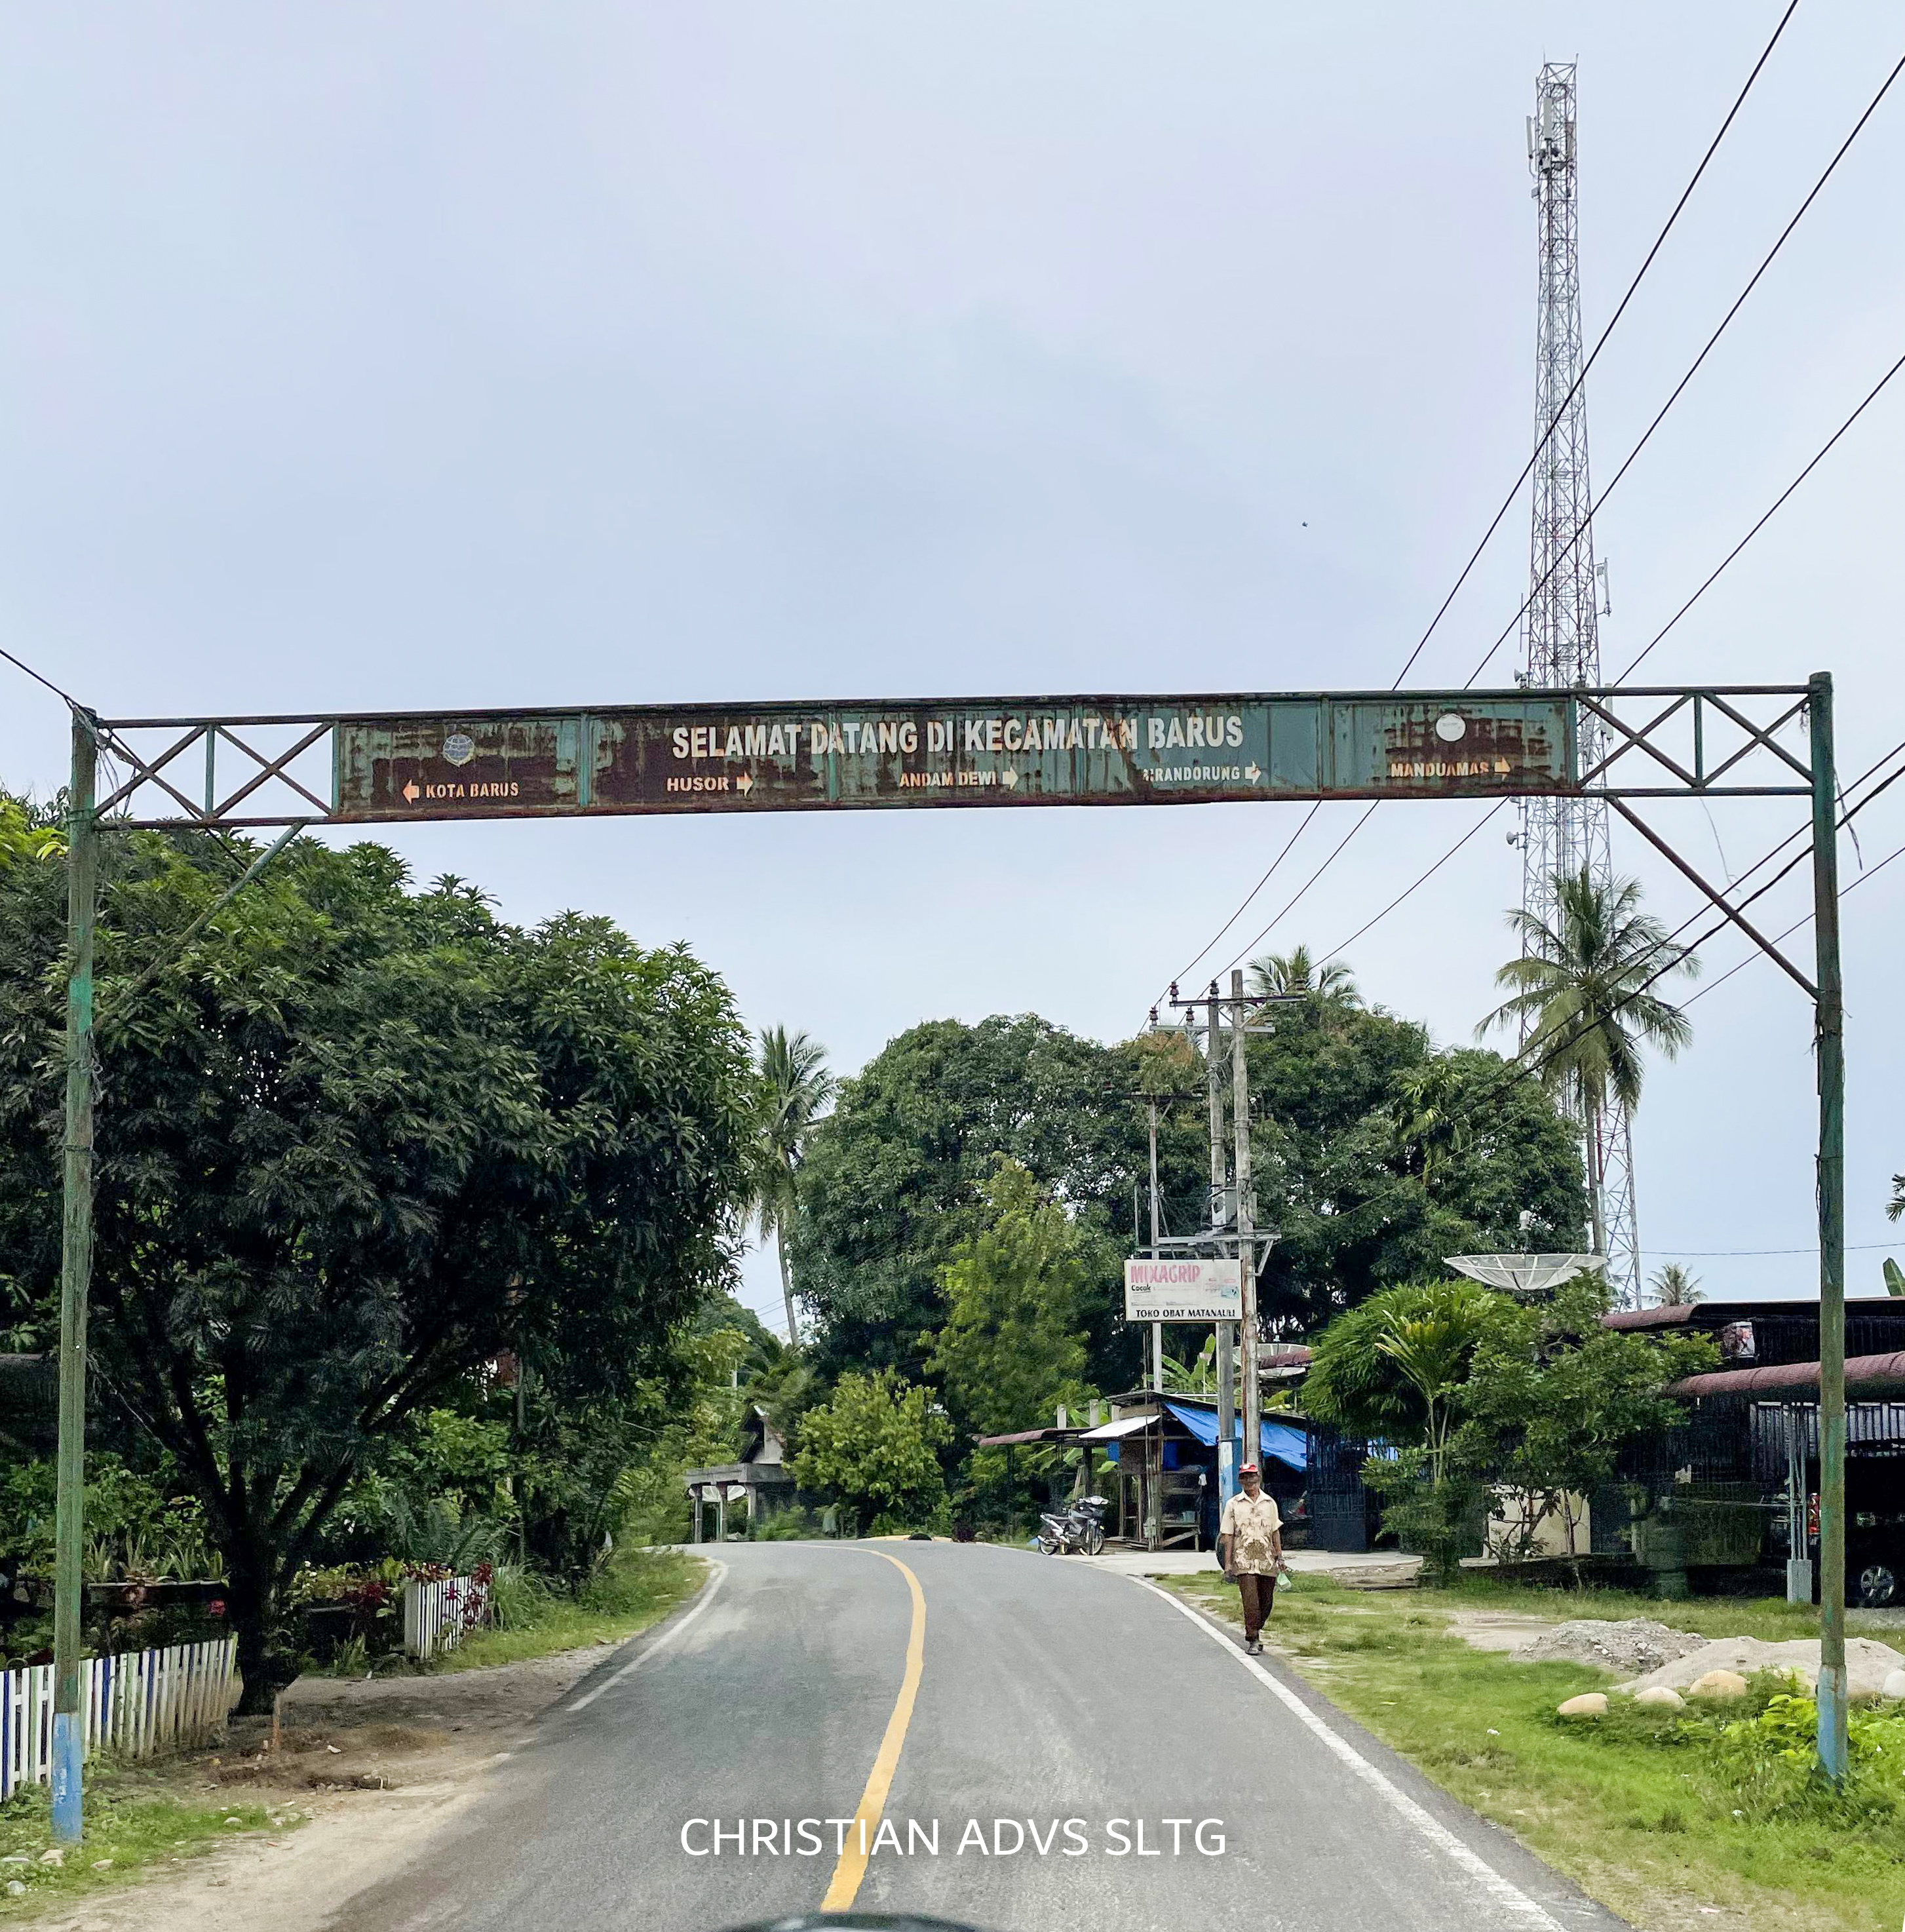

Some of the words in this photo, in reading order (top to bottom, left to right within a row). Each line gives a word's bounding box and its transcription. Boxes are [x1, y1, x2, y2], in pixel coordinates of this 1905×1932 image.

[672, 724, 801, 759] SELAMAT
[811, 722, 917, 754] DATANG
[927, 720, 954, 753] DI
[965, 718, 1138, 751] KECAMATAN
[1148, 716, 1243, 749] BARUS
[1391, 762, 1489, 778] MANDUAMAS
[666, 777, 729, 792] HUSOR
[899, 771, 954, 787] ANDAM
[958, 770, 997, 786] DEWI
[427, 784, 465, 798] KOTA
[470, 782, 519, 798] BARUS
[1130, 1265, 1201, 1284] MIXAGRIP
